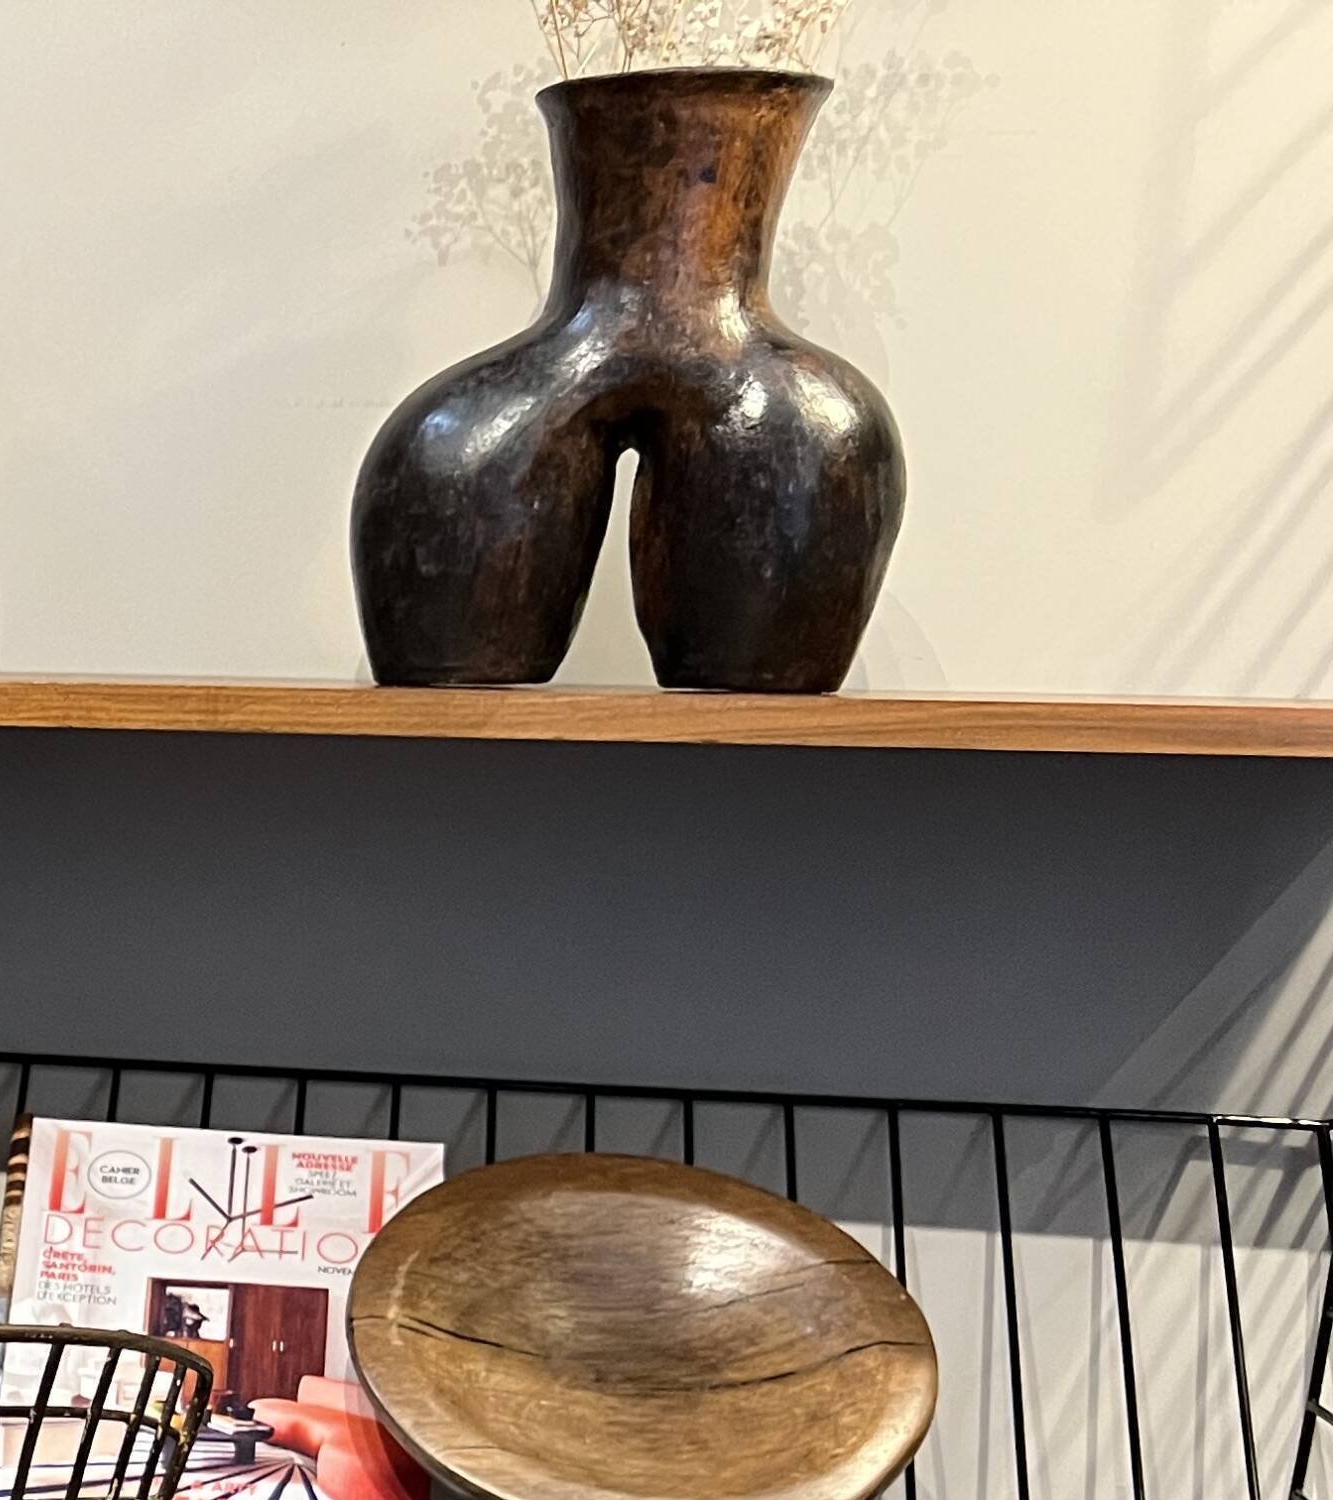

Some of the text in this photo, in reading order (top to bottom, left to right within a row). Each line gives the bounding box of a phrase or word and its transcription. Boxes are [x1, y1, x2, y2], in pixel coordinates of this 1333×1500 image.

[292, 1152, 358, 1165] NOUVELLE
[99, 1165, 140, 1175] CAHIER
[296, 1160, 353, 1172] ADRESSE
[42, 1130, 411, 1234] ELLE
[101, 1175, 136, 1185] BELGE
[44, 1213, 358, 1264] DECORATIO
[40, 1271, 79, 1282] PARIS
